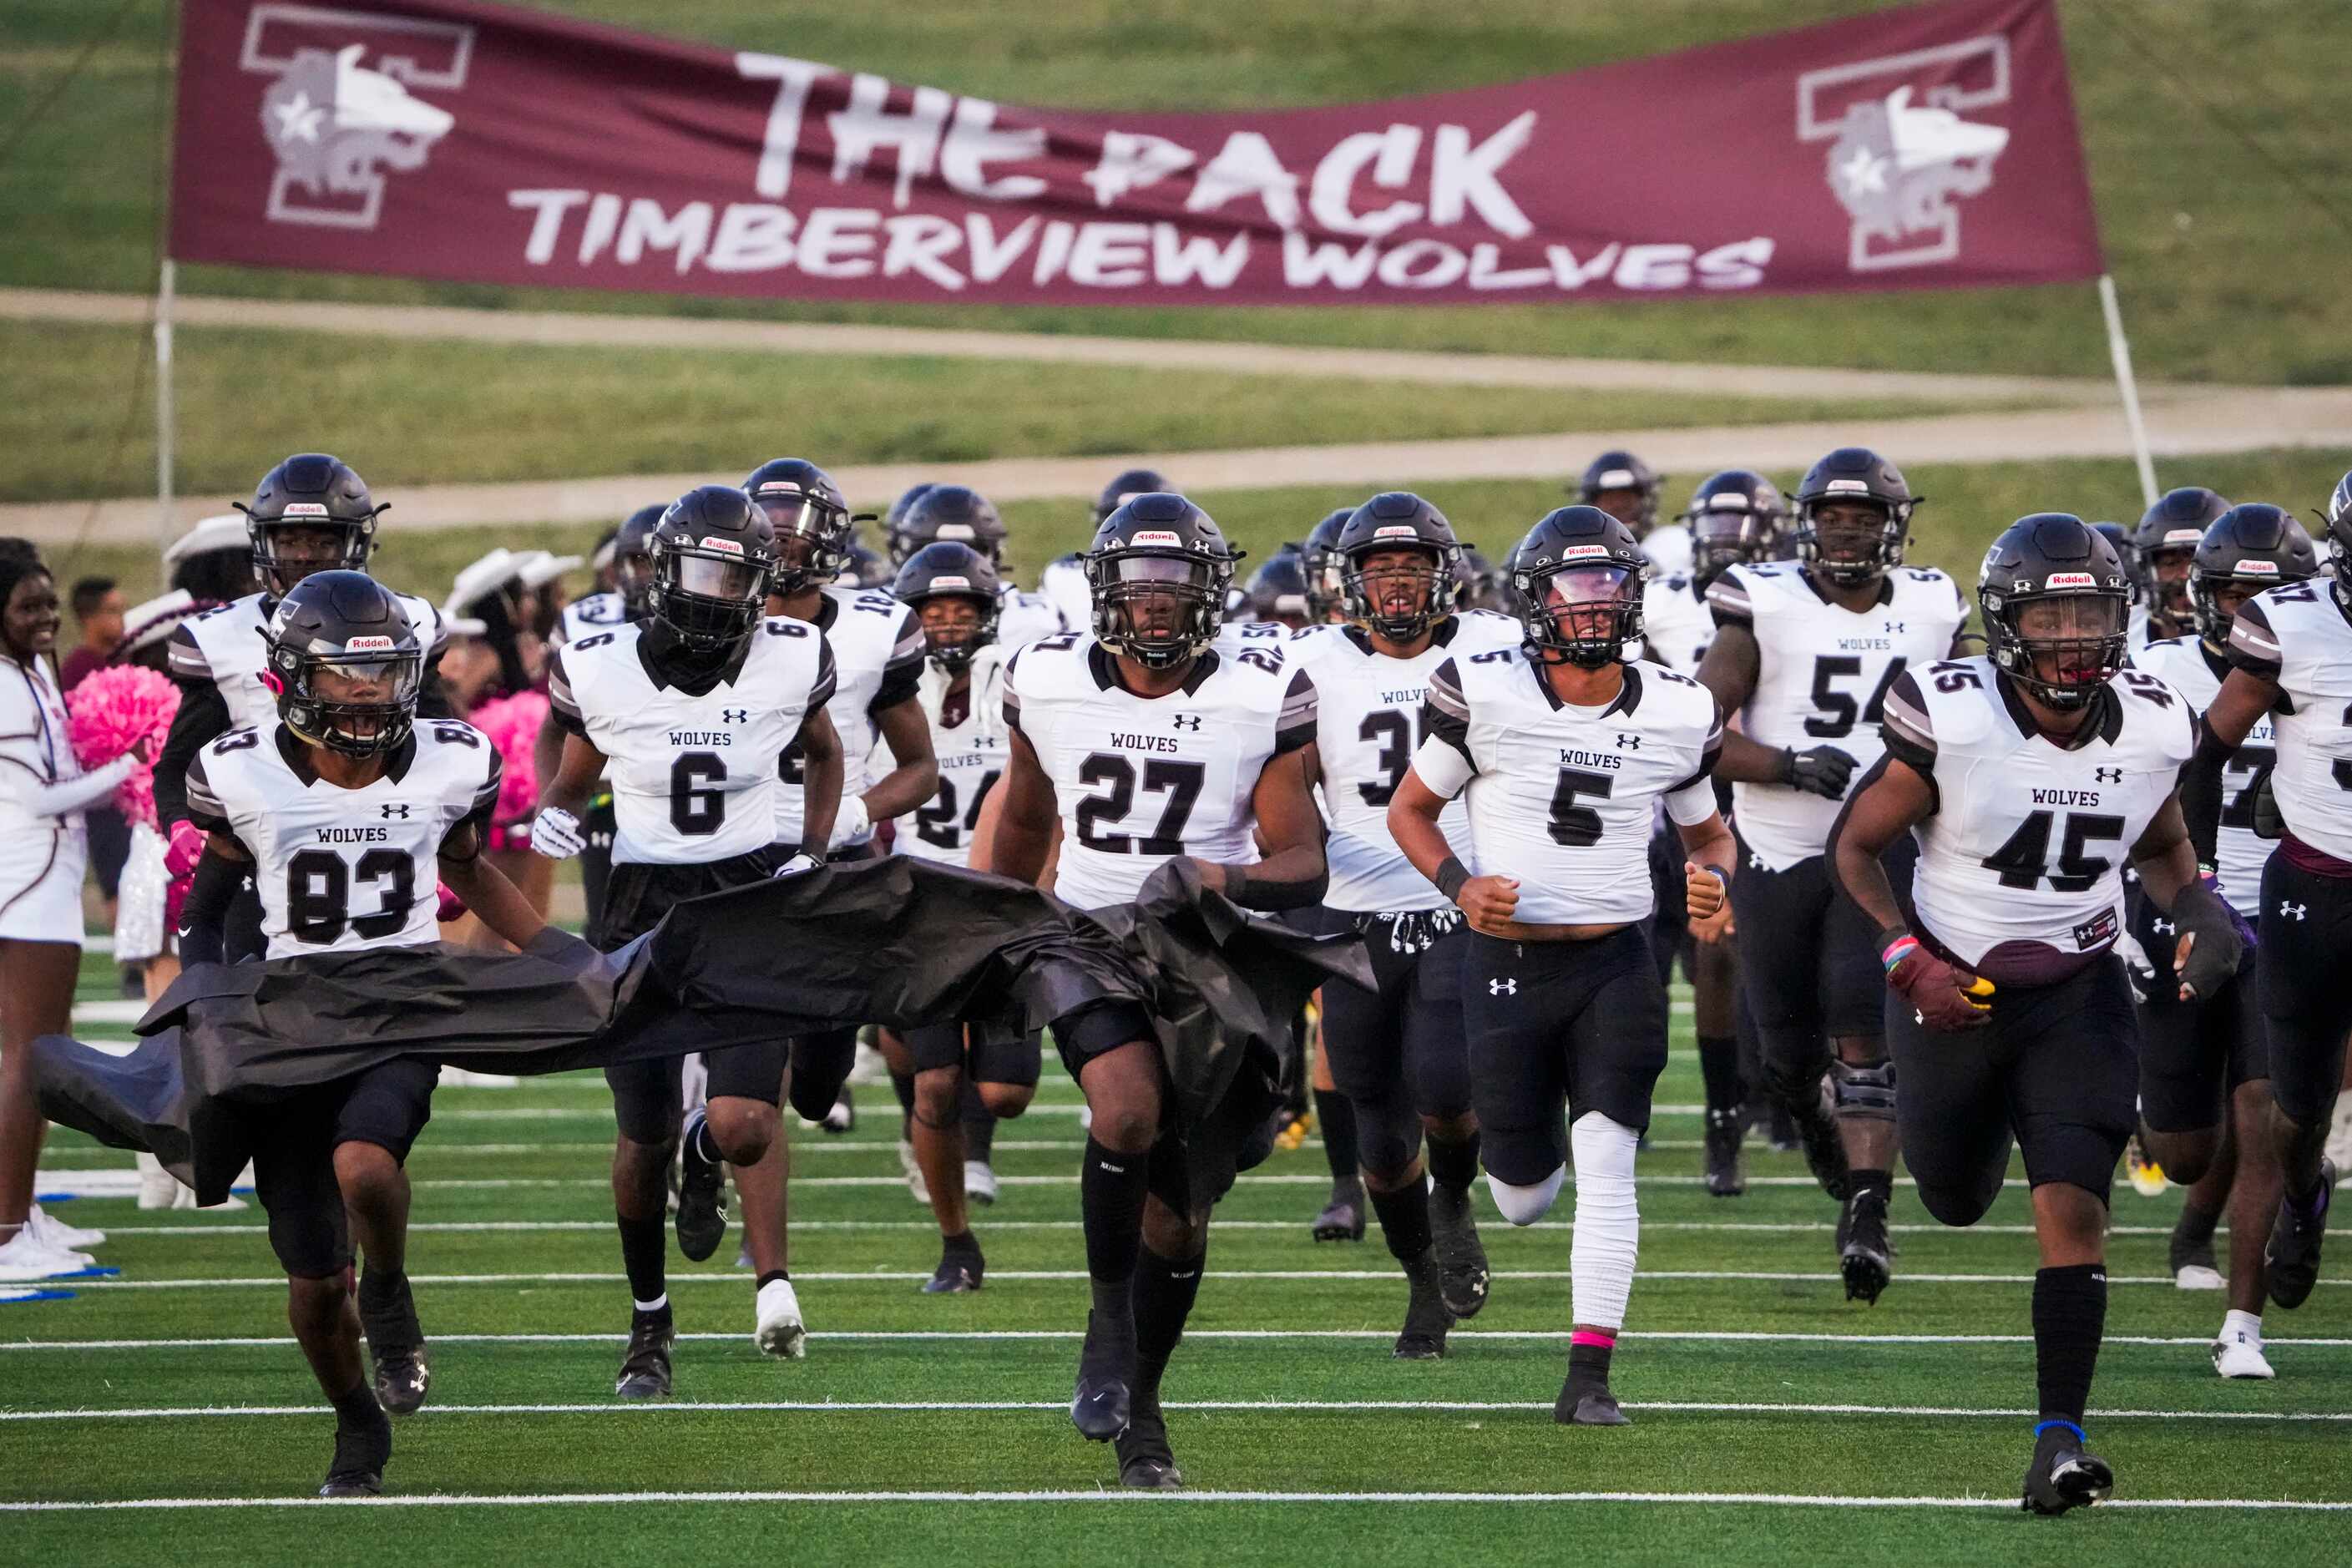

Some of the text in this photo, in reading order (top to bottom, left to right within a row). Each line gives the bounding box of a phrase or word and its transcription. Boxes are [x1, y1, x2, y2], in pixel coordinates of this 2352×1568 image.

[736, 52, 1537, 239] THE PACK
[508, 189, 1775, 291] TIMBERVIEW WOLVES
[289, 504, 322, 513] Riddell
[1378, 527, 1412, 536] Riddell
[706, 539, 741, 552] Riddell
[1568, 546, 1604, 556] Riddell
[2239, 562, 2274, 571] Riddell
[2052, 574, 2092, 585] Riddell
[352, 638, 390, 648] Riddell
[1838, 638, 1891, 650] WOLVES
[668, 731, 731, 746] WOLVES
[1110, 732, 1179, 753] WOLVES
[937, 754, 984, 769] OLVES
[1357, 706, 1429, 807] 3
[1560, 748, 1622, 769] WOLVES
[670, 751, 728, 836] 6
[2032, 788, 2101, 807] WOLVES
[1075, 751, 1206, 856] 27
[1546, 766, 1615, 847] 5
[316, 827, 387, 843] WOLVES
[1980, 809, 2126, 893] 45
[287, 847, 416, 946] 83
